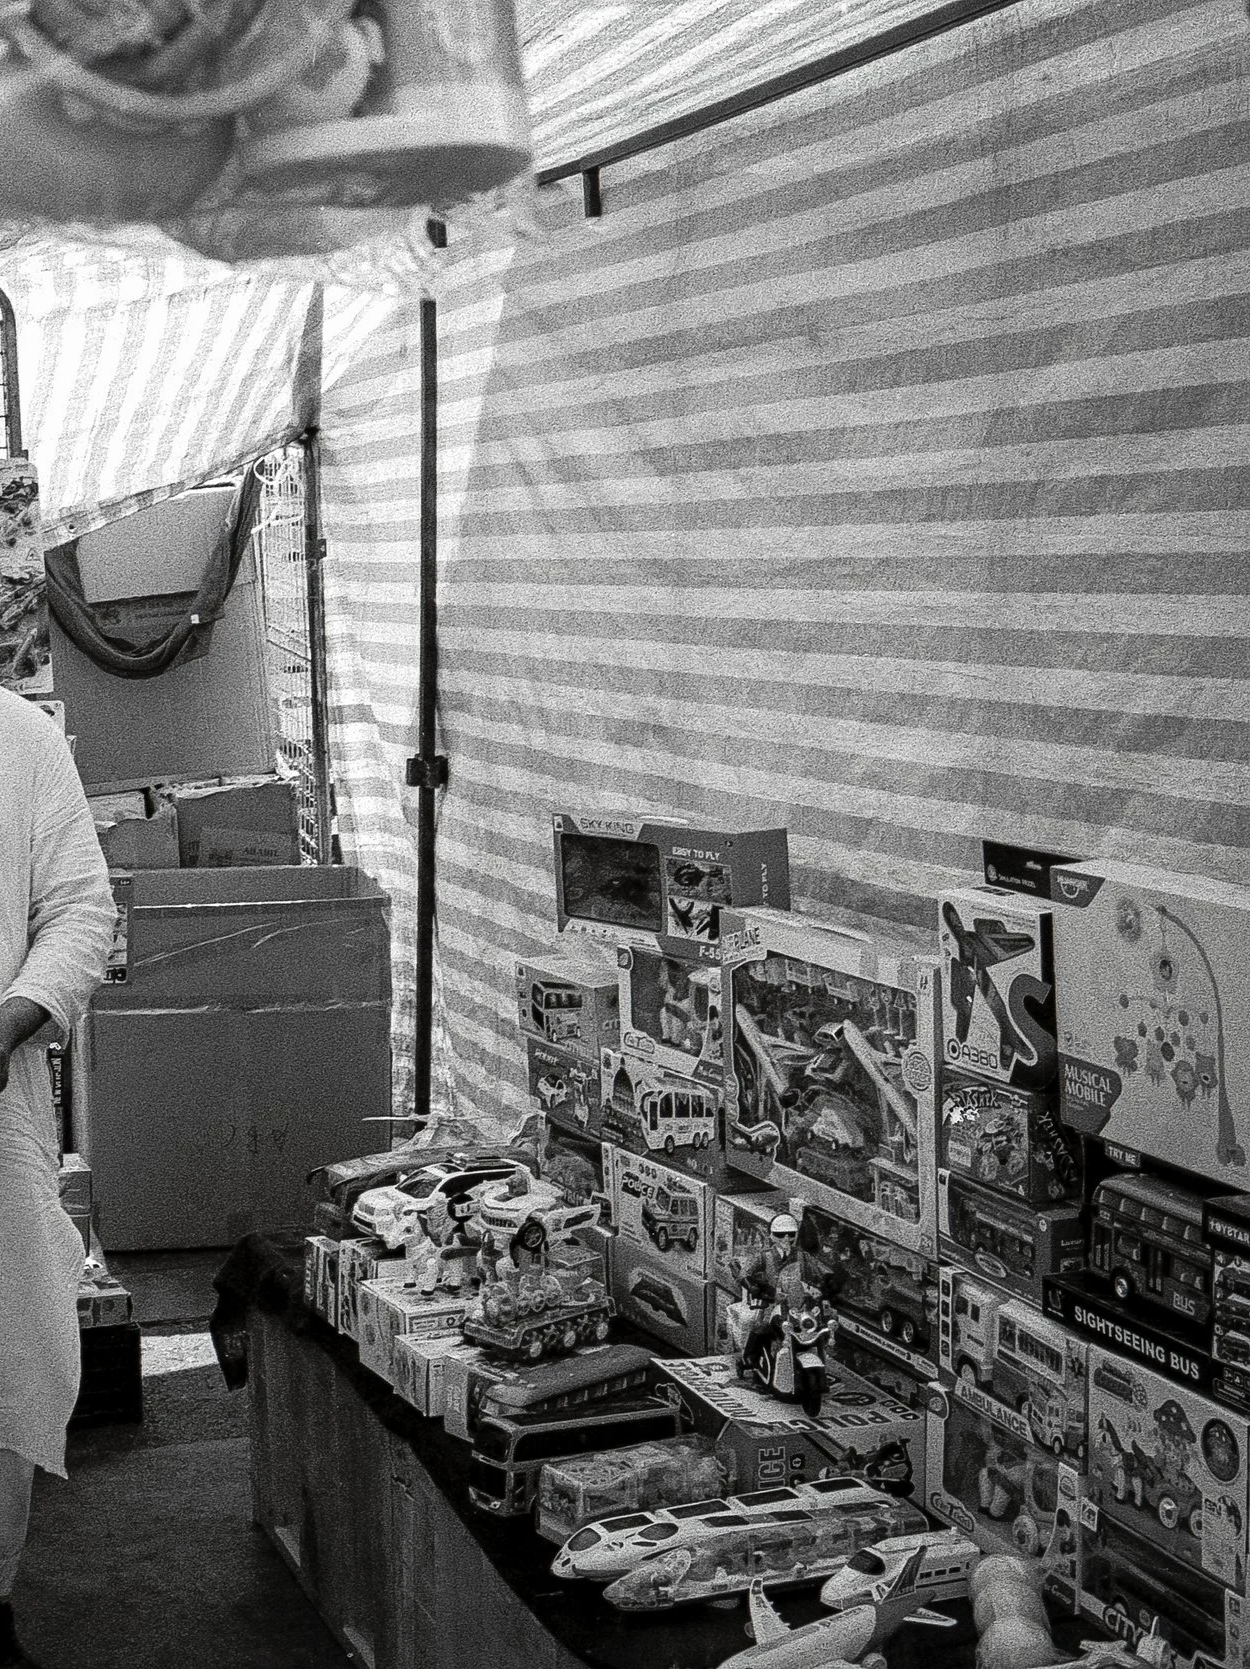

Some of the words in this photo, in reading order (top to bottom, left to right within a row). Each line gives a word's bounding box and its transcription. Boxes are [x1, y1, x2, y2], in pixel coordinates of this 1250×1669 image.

[580, 817, 606, 832] SKY
[607, 820, 635, 835] KING
[672, 846, 692, 857] EASY
[693, 849, 704, 859] TO
[705, 850, 720, 861] FLY
[961, 1044, 998, 1069] A380
[1064, 1063, 1113, 1093] MUSICAL
[1064, 1079, 1107, 1107] MOBILE
[1108, 1145, 1124, 1160] TRY
[1124, 1152, 1136, 1165] ME
[621, 1173, 654, 1198] POLICE
[1172, 1291, 1196, 1315] BUS
[1074, 1305, 1166, 1363] SIGHTSEEING
[1169, 1351, 1200, 1380] BUS
[960, 1384, 1029, 1439] AMBULANCE
